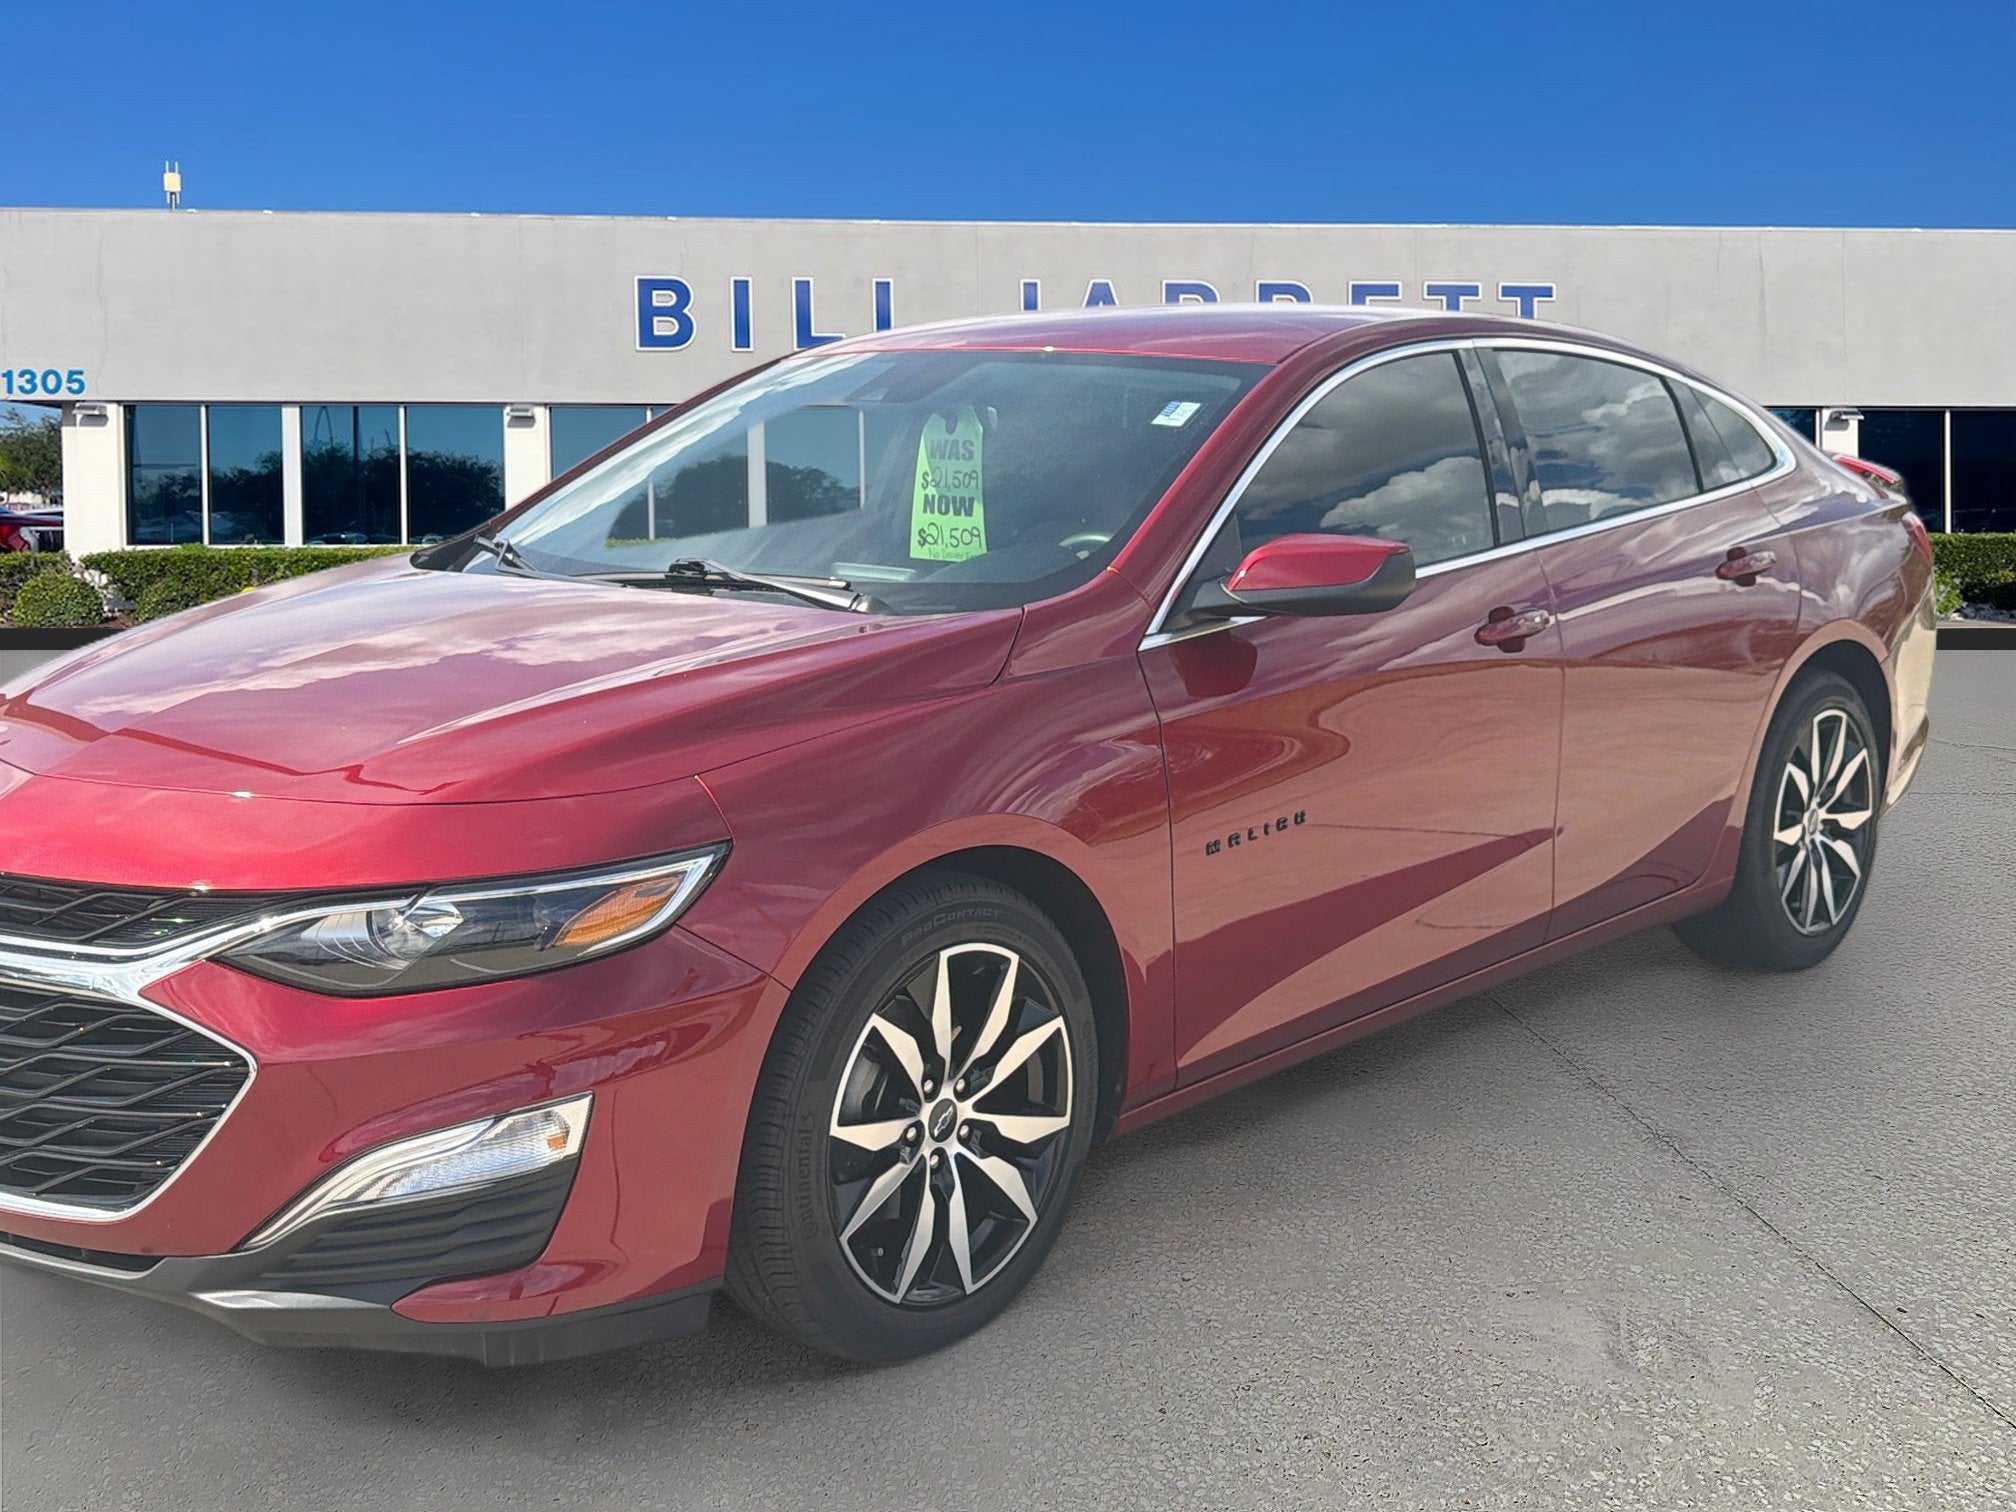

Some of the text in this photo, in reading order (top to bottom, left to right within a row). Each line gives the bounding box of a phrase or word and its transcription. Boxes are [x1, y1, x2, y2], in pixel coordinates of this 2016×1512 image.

[1, 368, 86, 395] 1305
[929, 439, 975, 461] WAS
[922, 494, 976, 517] NOW
[917, 522, 982, 549] $21,509
[1205, 810, 1306, 856] MALIBU
